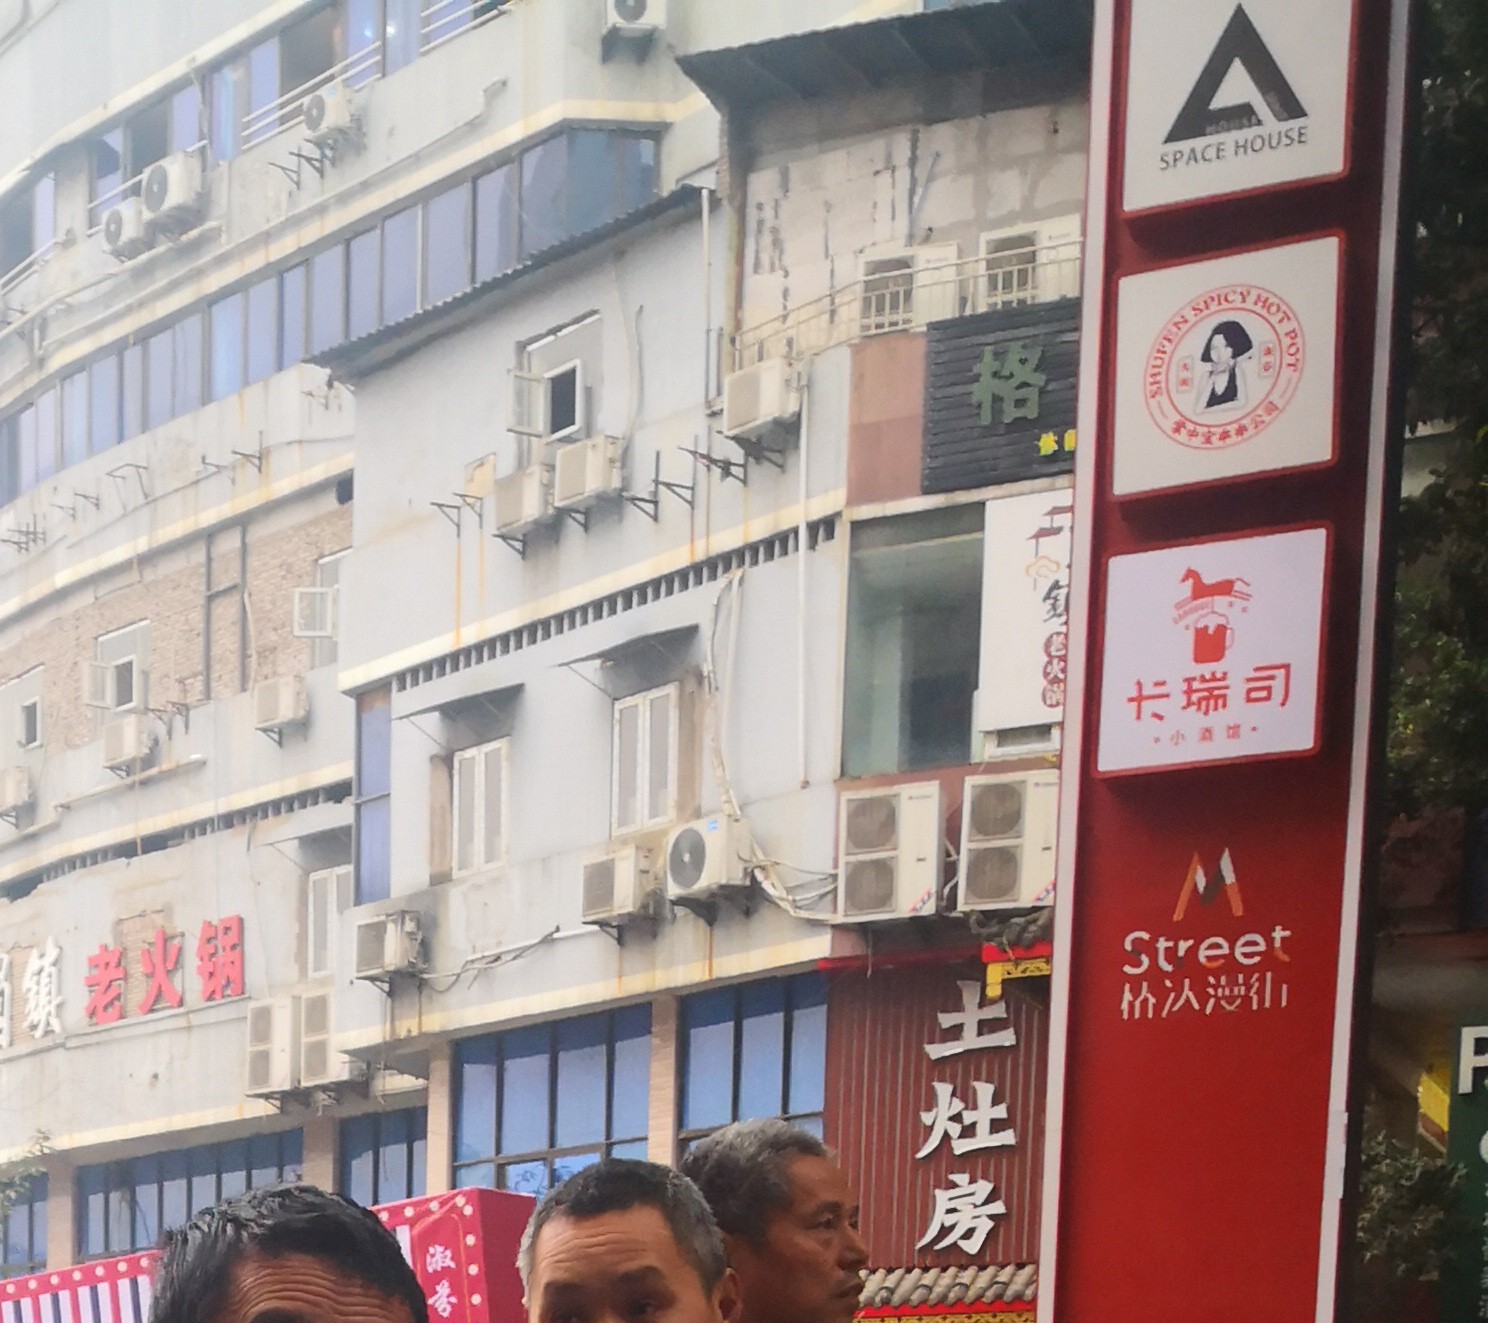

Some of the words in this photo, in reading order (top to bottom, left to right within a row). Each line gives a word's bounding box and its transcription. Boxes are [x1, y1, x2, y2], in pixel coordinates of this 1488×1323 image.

[1159, 141, 1228, 171] SPACE
[1233, 125, 1309, 157] HOUSE
[1148, 313, 1190, 400] SHUFEN
[1191, 288, 1251, 318] SPICY
[1252, 292, 1291, 326] HOT
[1282, 326, 1300, 373] POT
[972, 341, 1048, 427] 格
[1127, 662, 1291, 721] 卡瑞司
[1122, 925, 1292, 976] Street
[915, 980, 1018, 1256] 土灶房
